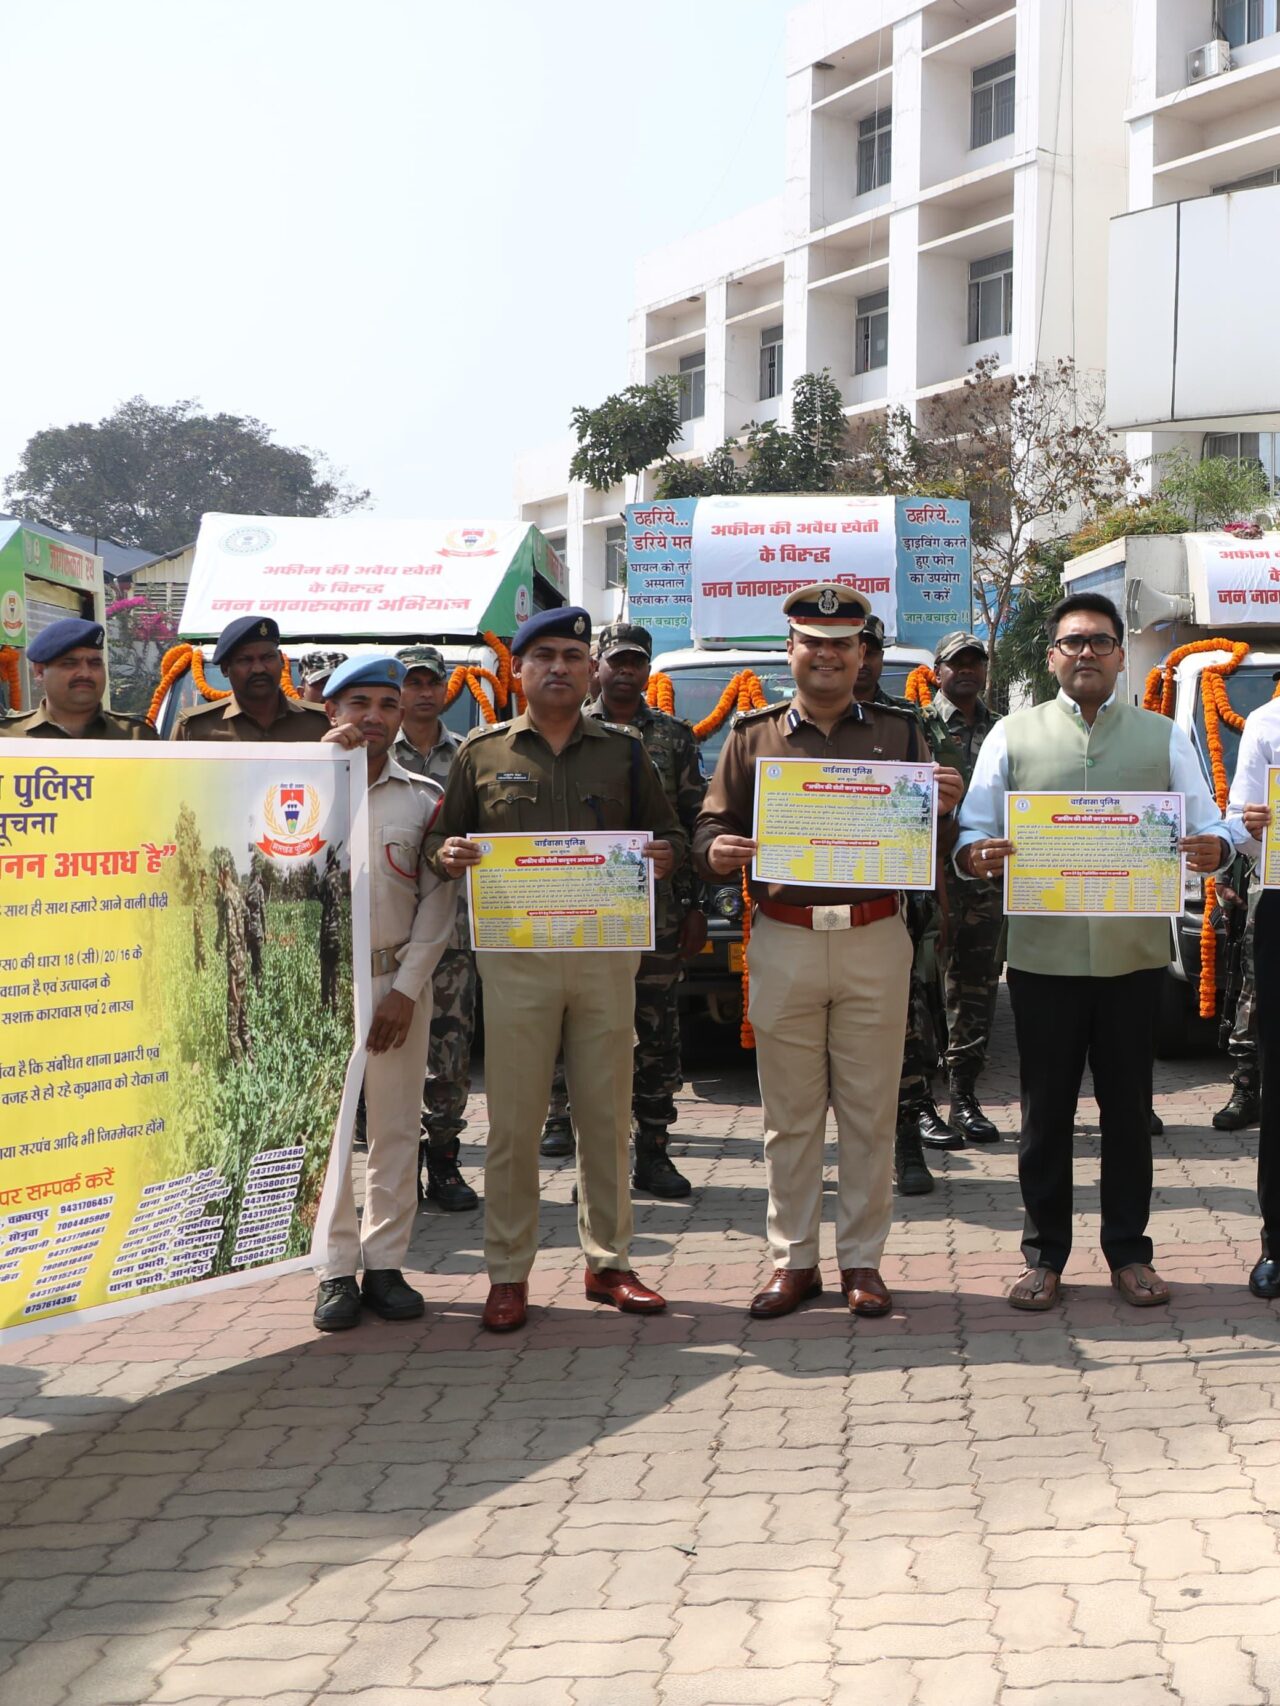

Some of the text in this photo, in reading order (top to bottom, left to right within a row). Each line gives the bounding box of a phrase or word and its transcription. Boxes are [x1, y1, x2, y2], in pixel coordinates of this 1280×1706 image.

[634, 507, 688, 526] ठहरिये...
[906, 505, 959, 524] ठहरिये...
[711, 520, 878, 535] अफीम की अवैध खेती
[632, 532, 692, 550] डरिये मत
[903, 535, 967, 550] ड्राइविंग करते
[759, 544, 830, 563] के विरुद्ध
[916, 553, 954, 568] हुए फोन
[263, 564, 441, 575] अफीम की अवैध खेती
[631, 560, 675, 572] घायल को
[910, 570, 960, 582] का उपयोग
[309, 582, 384, 594] के विरुद्ध
[645, 580, 684, 588] अस्पताल
[702, 582, 732, 597] जन
[923, 588, 951, 600] न करें
[1218, 590, 1246, 604] जन
[212, 600, 254, 612] जन
[377, 596, 471, 611] अभियान
[634, 615, 687, 626] जान बचाइये
[905, 611, 957, 622] जान बचाइये
[852, 766, 872, 776] पुलिस
[14, 766, 94, 807] पुलिस
[565, 838, 585, 848] पुलिस
[54, 851, 139, 877] अपराध
[4, 892, 168, 917] साथ ही साथ हमारे आने वाली पीढ़ी
[21, 944, 143, 969] की धारा 18 के
[33, 973, 110, 996] है एवं उत्पादन के
[36, 999, 134, 1021] कारावास एवं लाख
[19, 1045, 144, 1077] है कि थाना प्रभारी
[2, 1071, 168, 1105] वजह से हो रहे कुप्रभाव को रोका जा
[19, 1118, 165, 1156] सरपंच आदि भी जिम्मेदार होंगे
[250, 1162, 301, 1176] 9431706467
[0, 1167, 115, 1206] पर सम्पर्क करें
[61, 1196, 113, 1213] 9431706457
[112, 1247, 215, 1275] थाना मनोहरपुर
[110, 1281, 132, 1291] थाना
